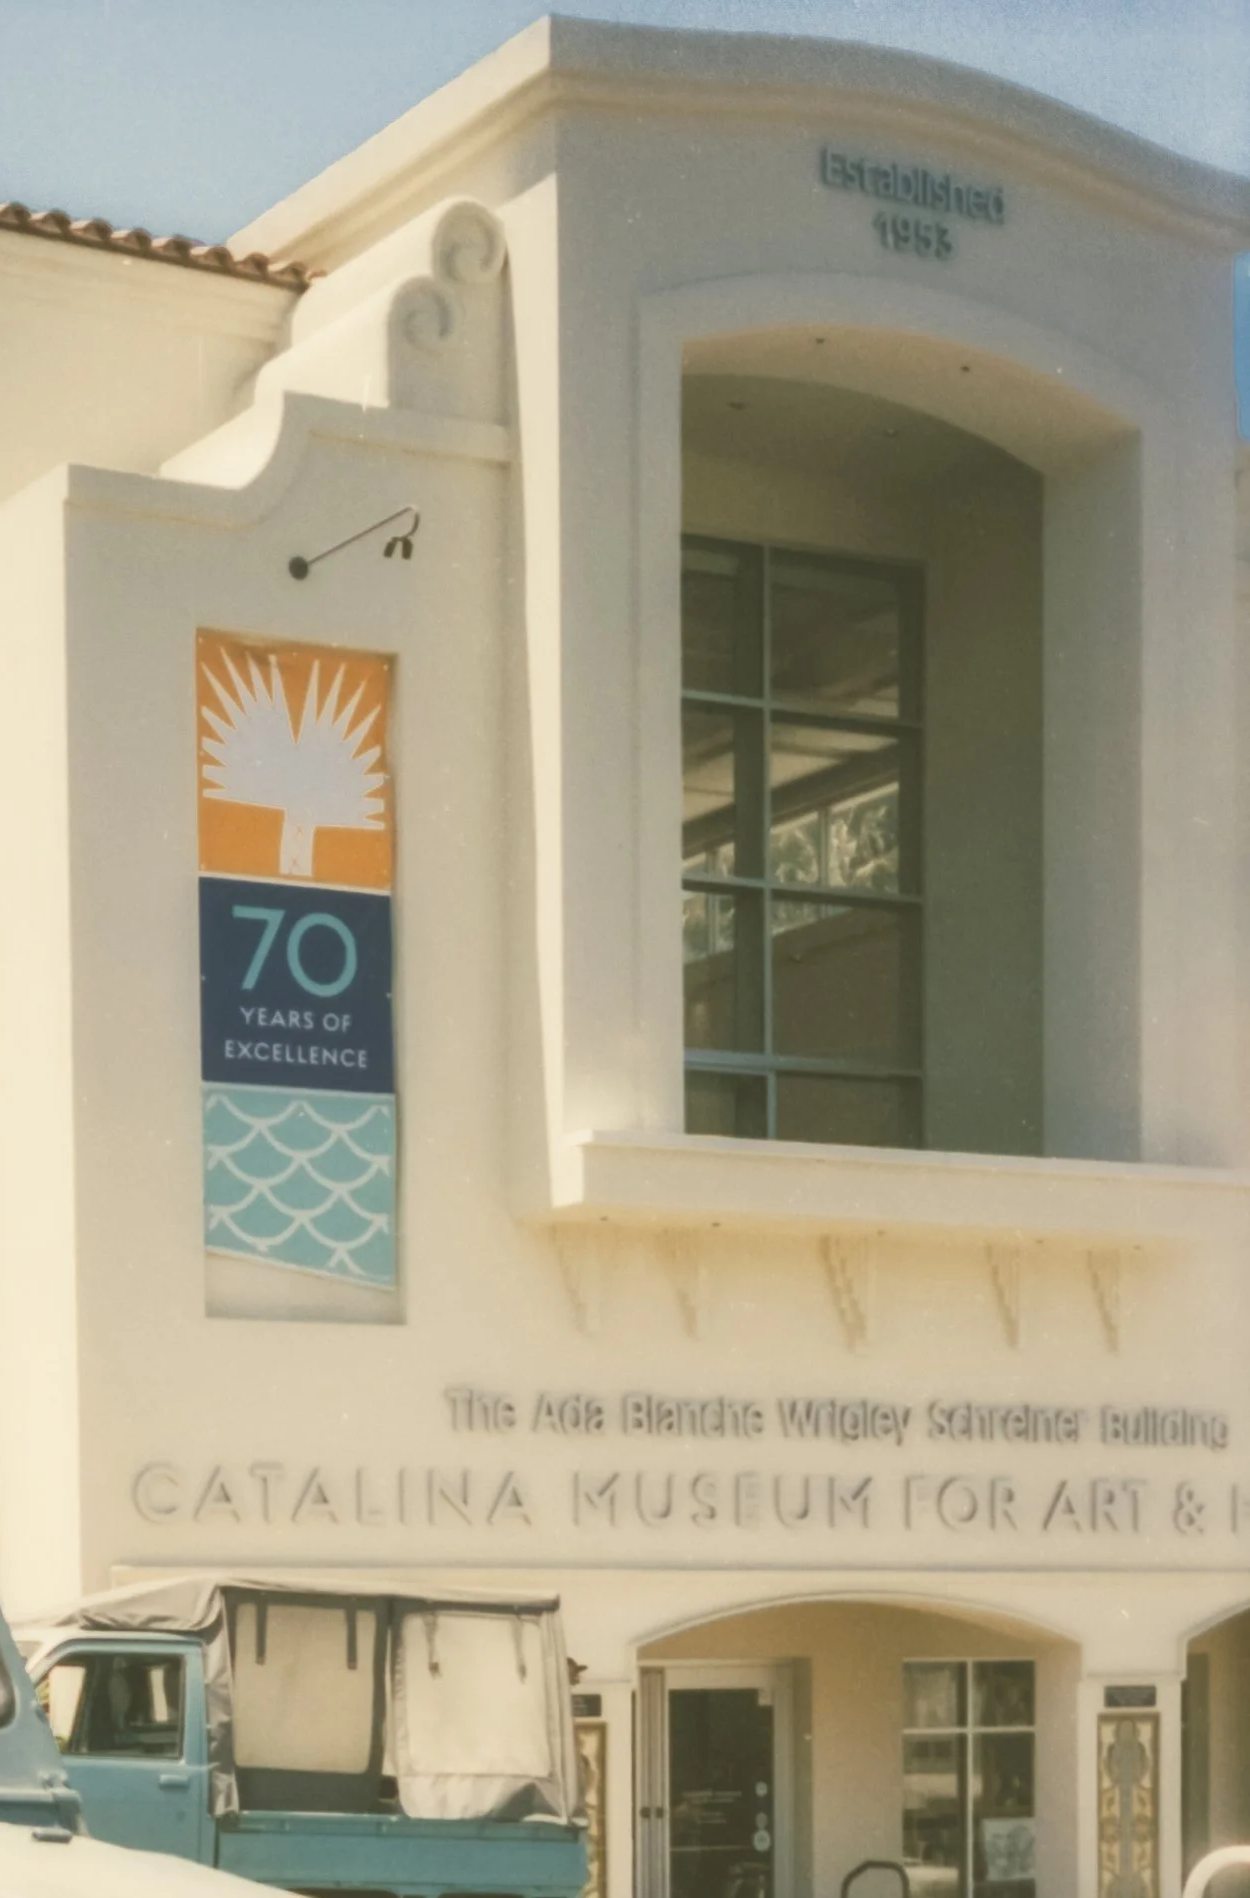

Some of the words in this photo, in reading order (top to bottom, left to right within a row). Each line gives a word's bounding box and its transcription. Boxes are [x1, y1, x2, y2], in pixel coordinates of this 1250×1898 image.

[820, 147, 1004, 226] Established
[872, 210, 953, 261] 1953
[232, 905, 357, 997] 70
[239, 1006, 314, 1030] YEARS
[323, 1013, 352, 1033] OF
[225, 1039, 368, 1069] EXCELLENCE
[443, 1384, 517, 1434] The
[620, 1391, 764, 1439] Blanche
[775, 1397, 911, 1447] Wrigley
[1099, 1404, 1228, 1452] Building
[130, 1461, 533, 1528] CATALINA
[571, 1469, 874, 1530] MUSEUM
[903, 1474, 1018, 1533] FOR
[1041, 1477, 1148, 1534] ART
[1171, 1479, 1206, 1536] &
